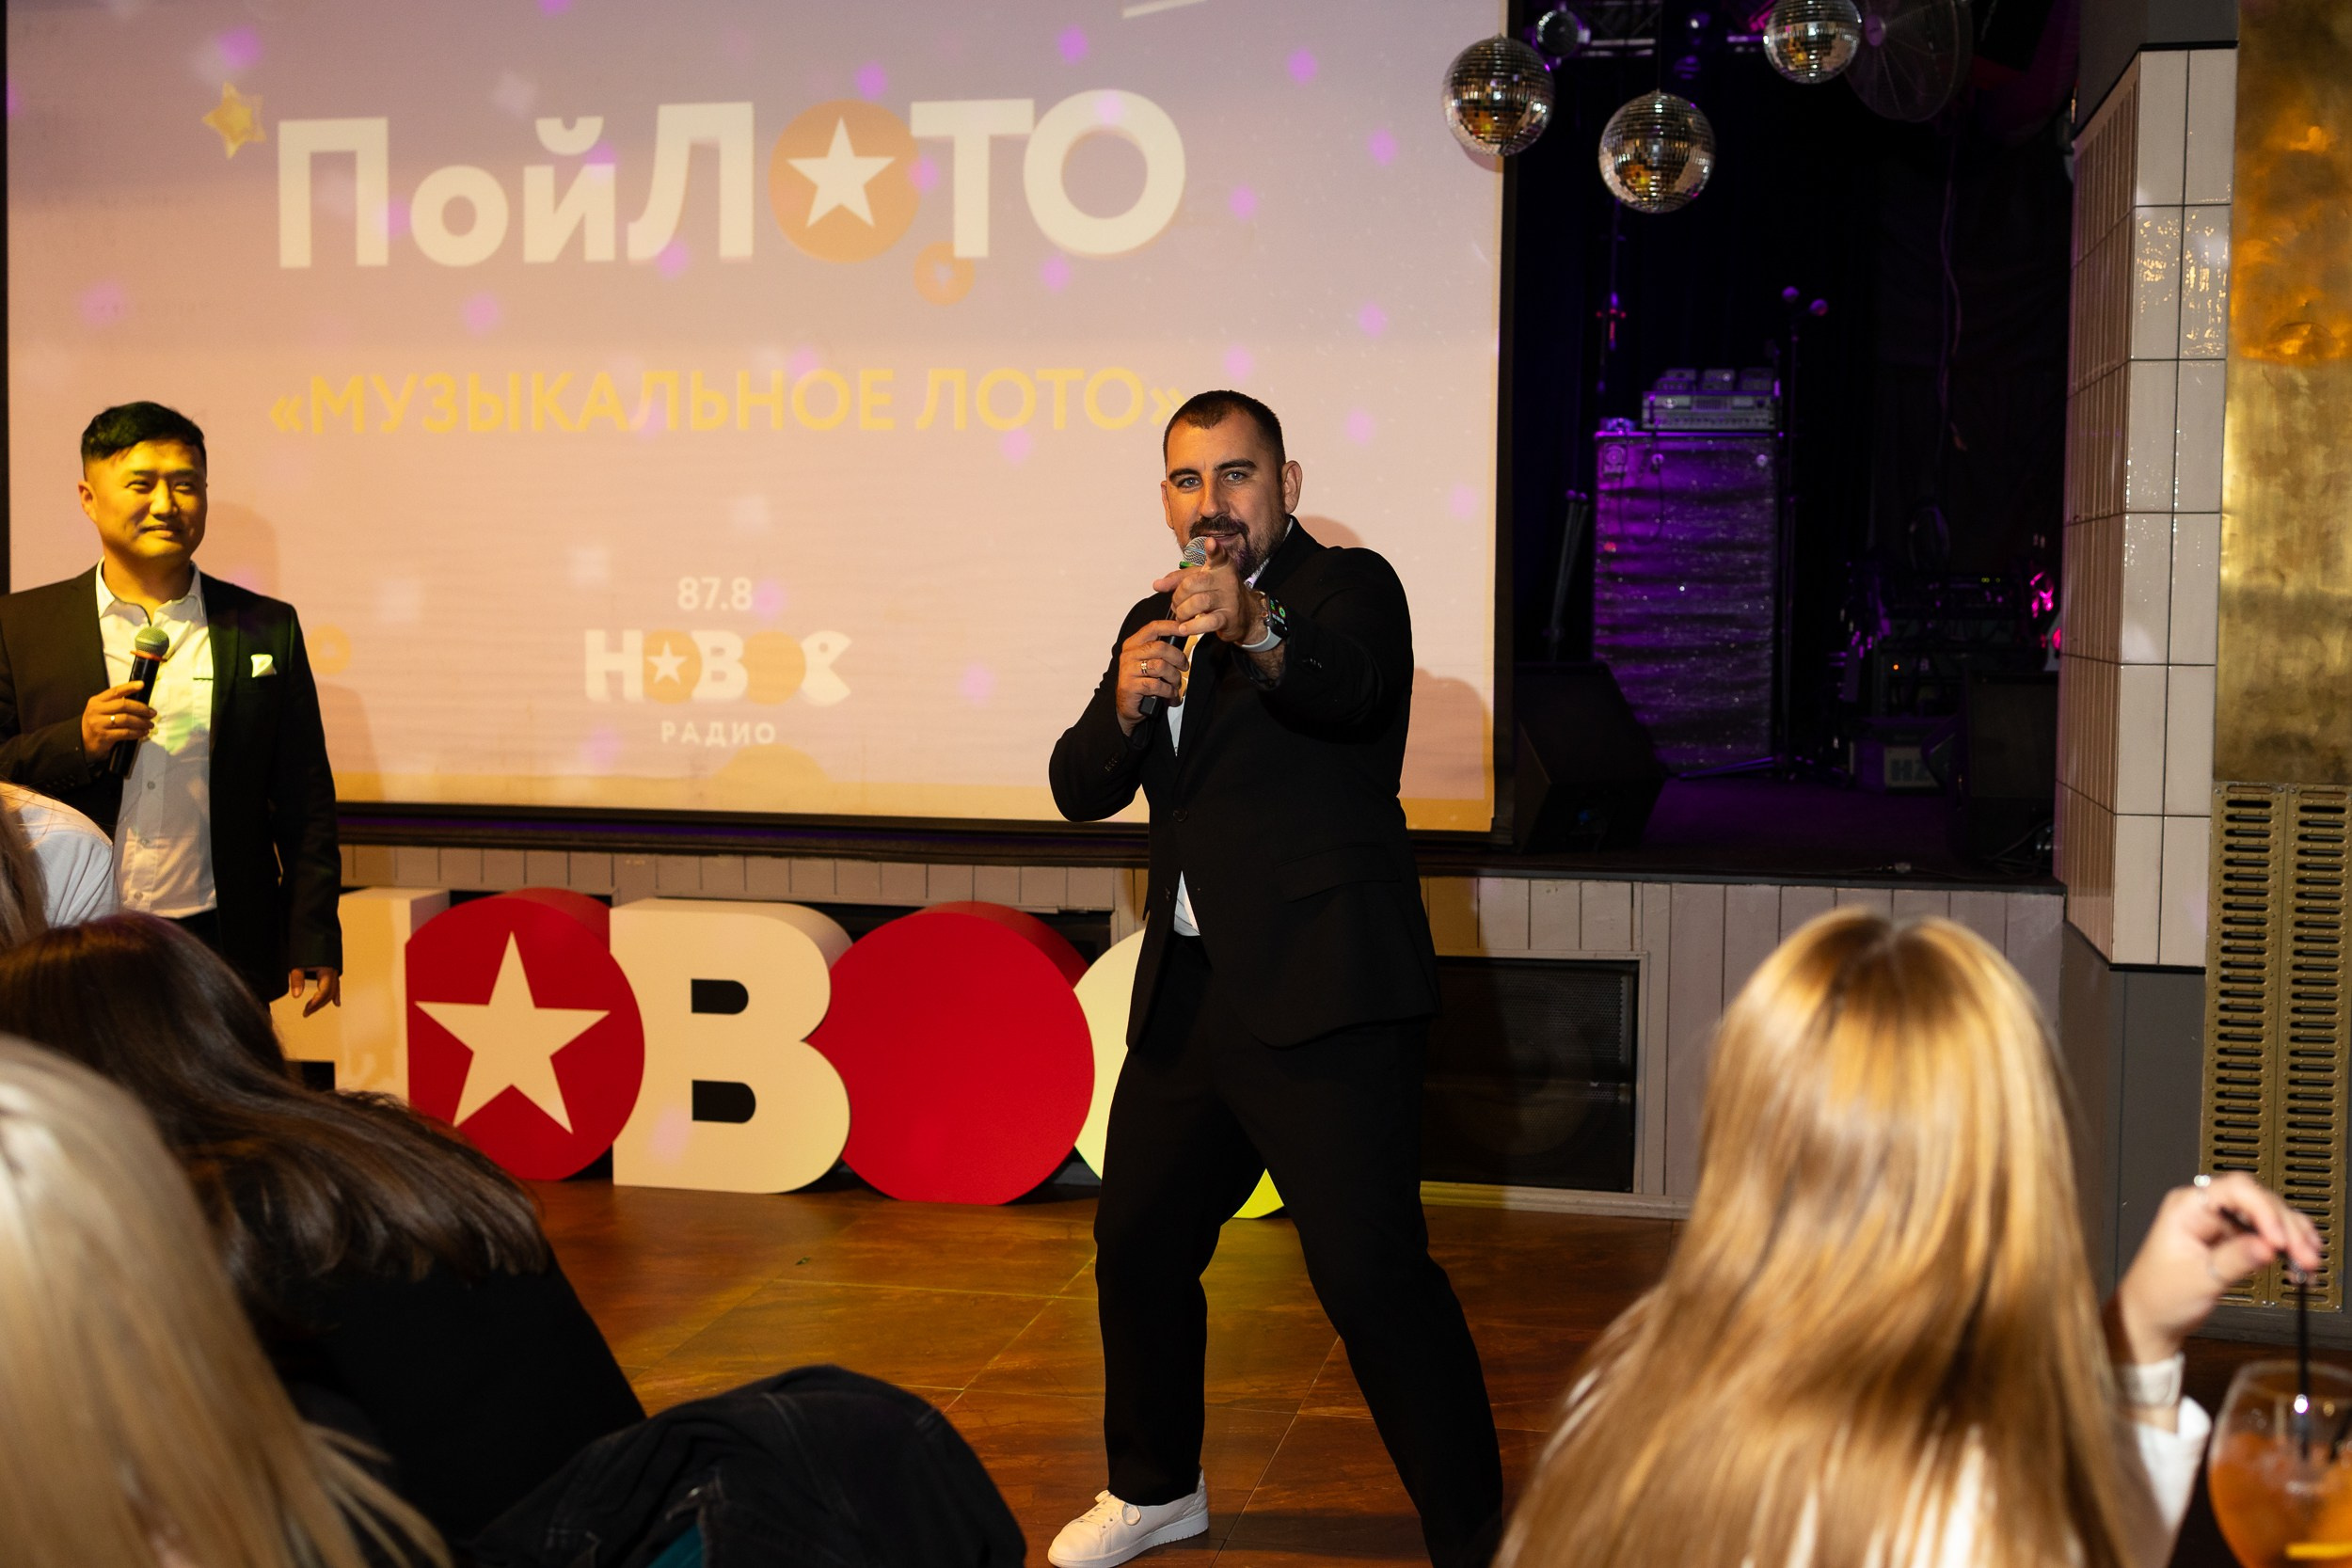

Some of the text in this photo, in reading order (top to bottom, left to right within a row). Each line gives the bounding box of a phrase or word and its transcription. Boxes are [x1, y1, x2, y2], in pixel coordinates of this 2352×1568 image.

[270, 368, 894, 436] «МУЗЫКАЛЬНОЕ
[677, 576, 753, 611] 87.8
[661, 721, 775, 747] РАДИО
